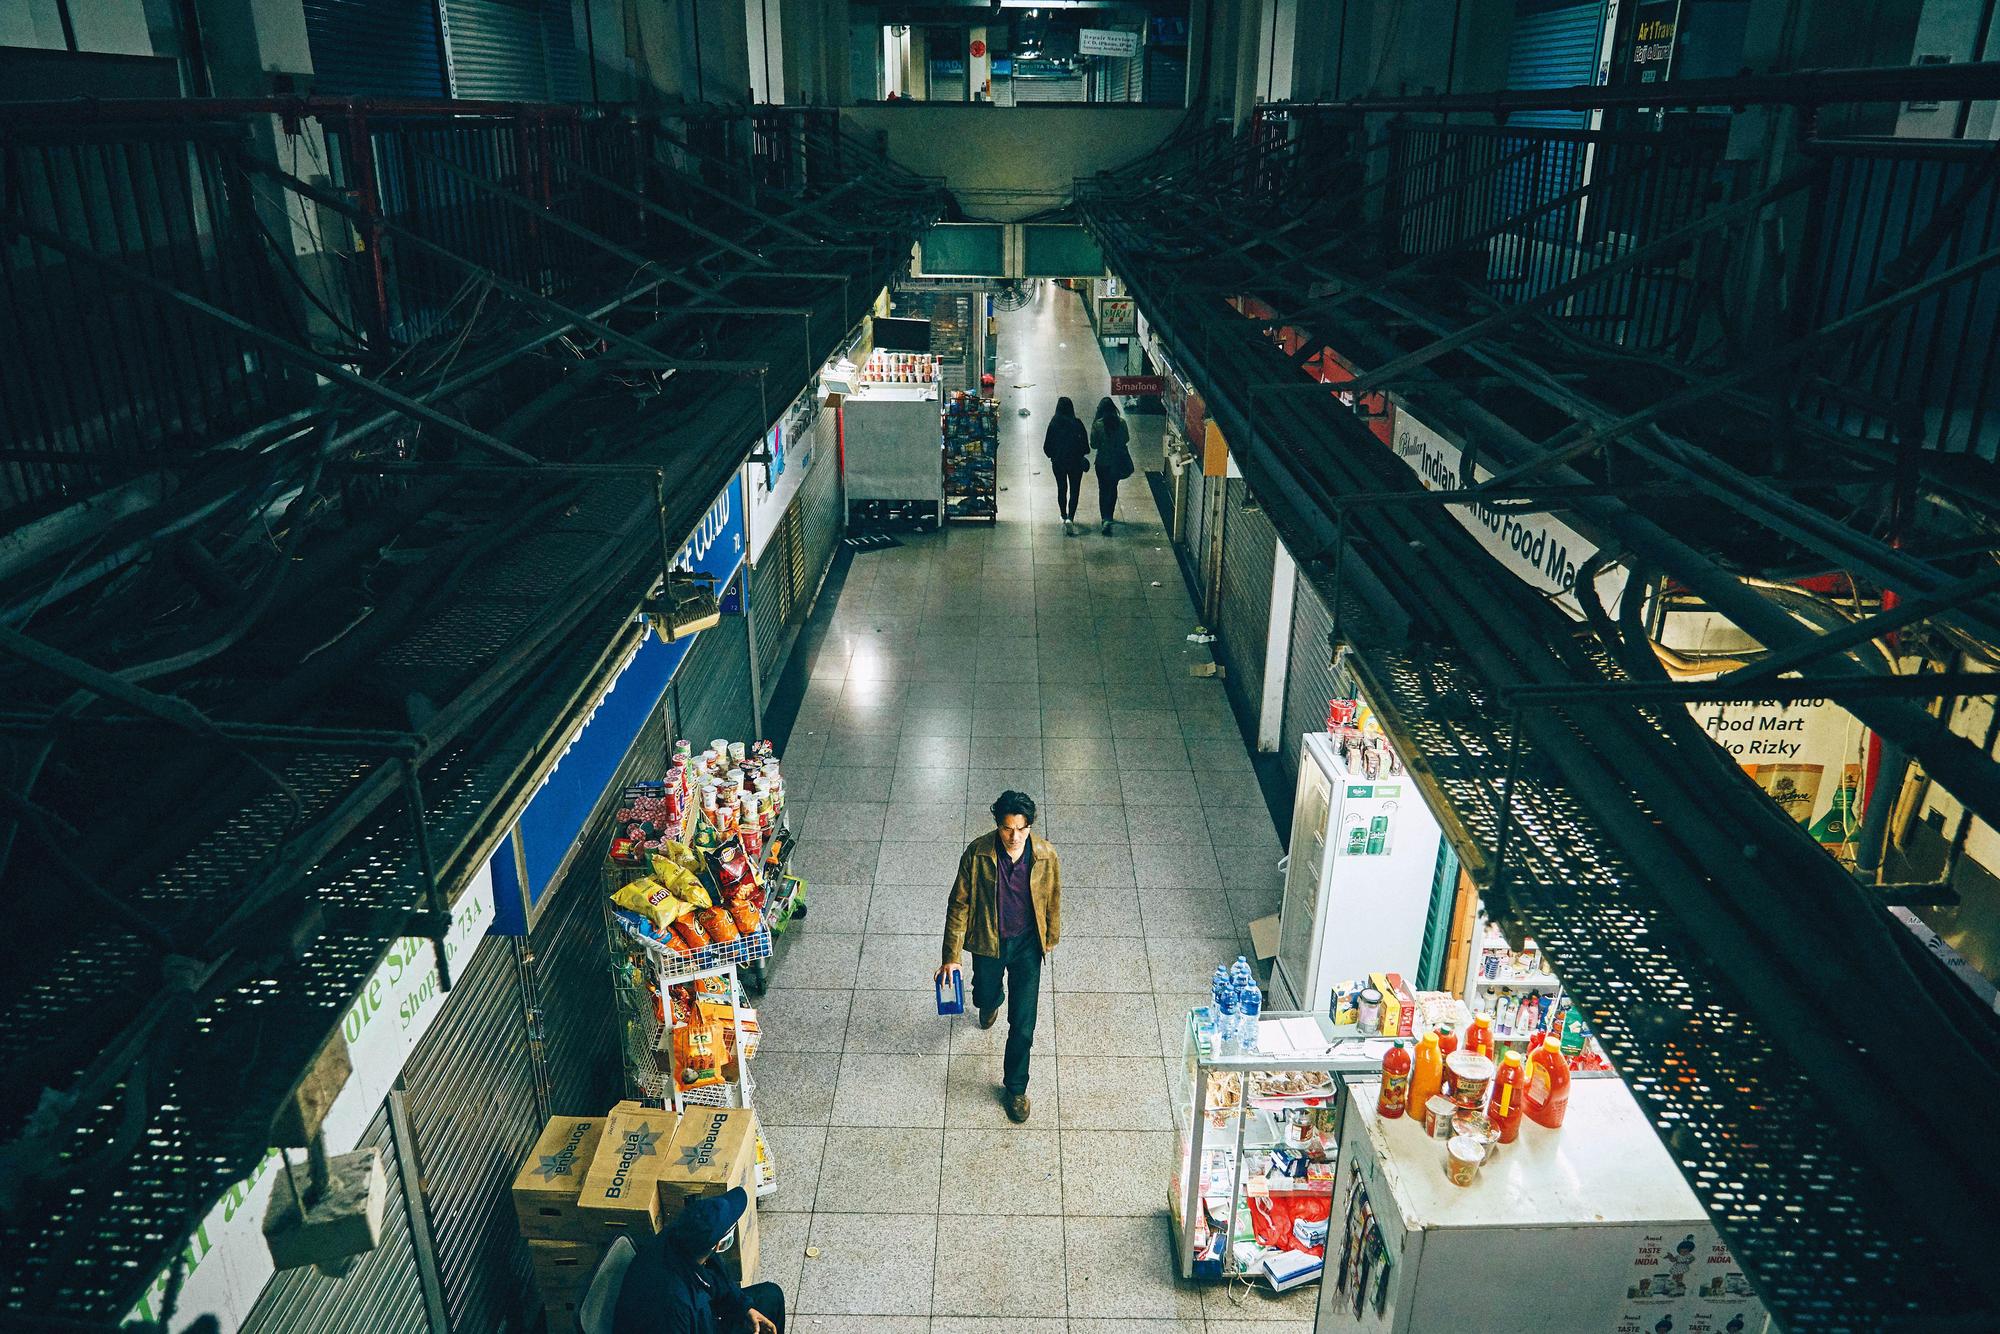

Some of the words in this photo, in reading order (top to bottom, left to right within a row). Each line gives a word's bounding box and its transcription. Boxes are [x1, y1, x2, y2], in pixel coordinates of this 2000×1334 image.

[1637, 22, 1649, 41] Air
[1421, 442, 1455, 490] Indian
[1502, 515, 1547, 569] Food
[1545, 539, 1575, 590] Ma
[1706, 716, 1755, 731] Food
[1759, 716, 1805, 731] Mart
[1749, 739, 1801, 758] Rizky
[457, 896, 483, 939] 73A
[399, 969, 436, 1031] Shop
[554, 1122, 591, 1175] Bonaqua
[697, 1113, 728, 1165] Bonaqua
[605, 1133, 640, 1199] Bonaqua
[1634, 1257, 1659, 1266] INDIA
[1706, 1256, 1732, 1264] INDIA
[1688, 1324, 1712, 1332] TASTE
